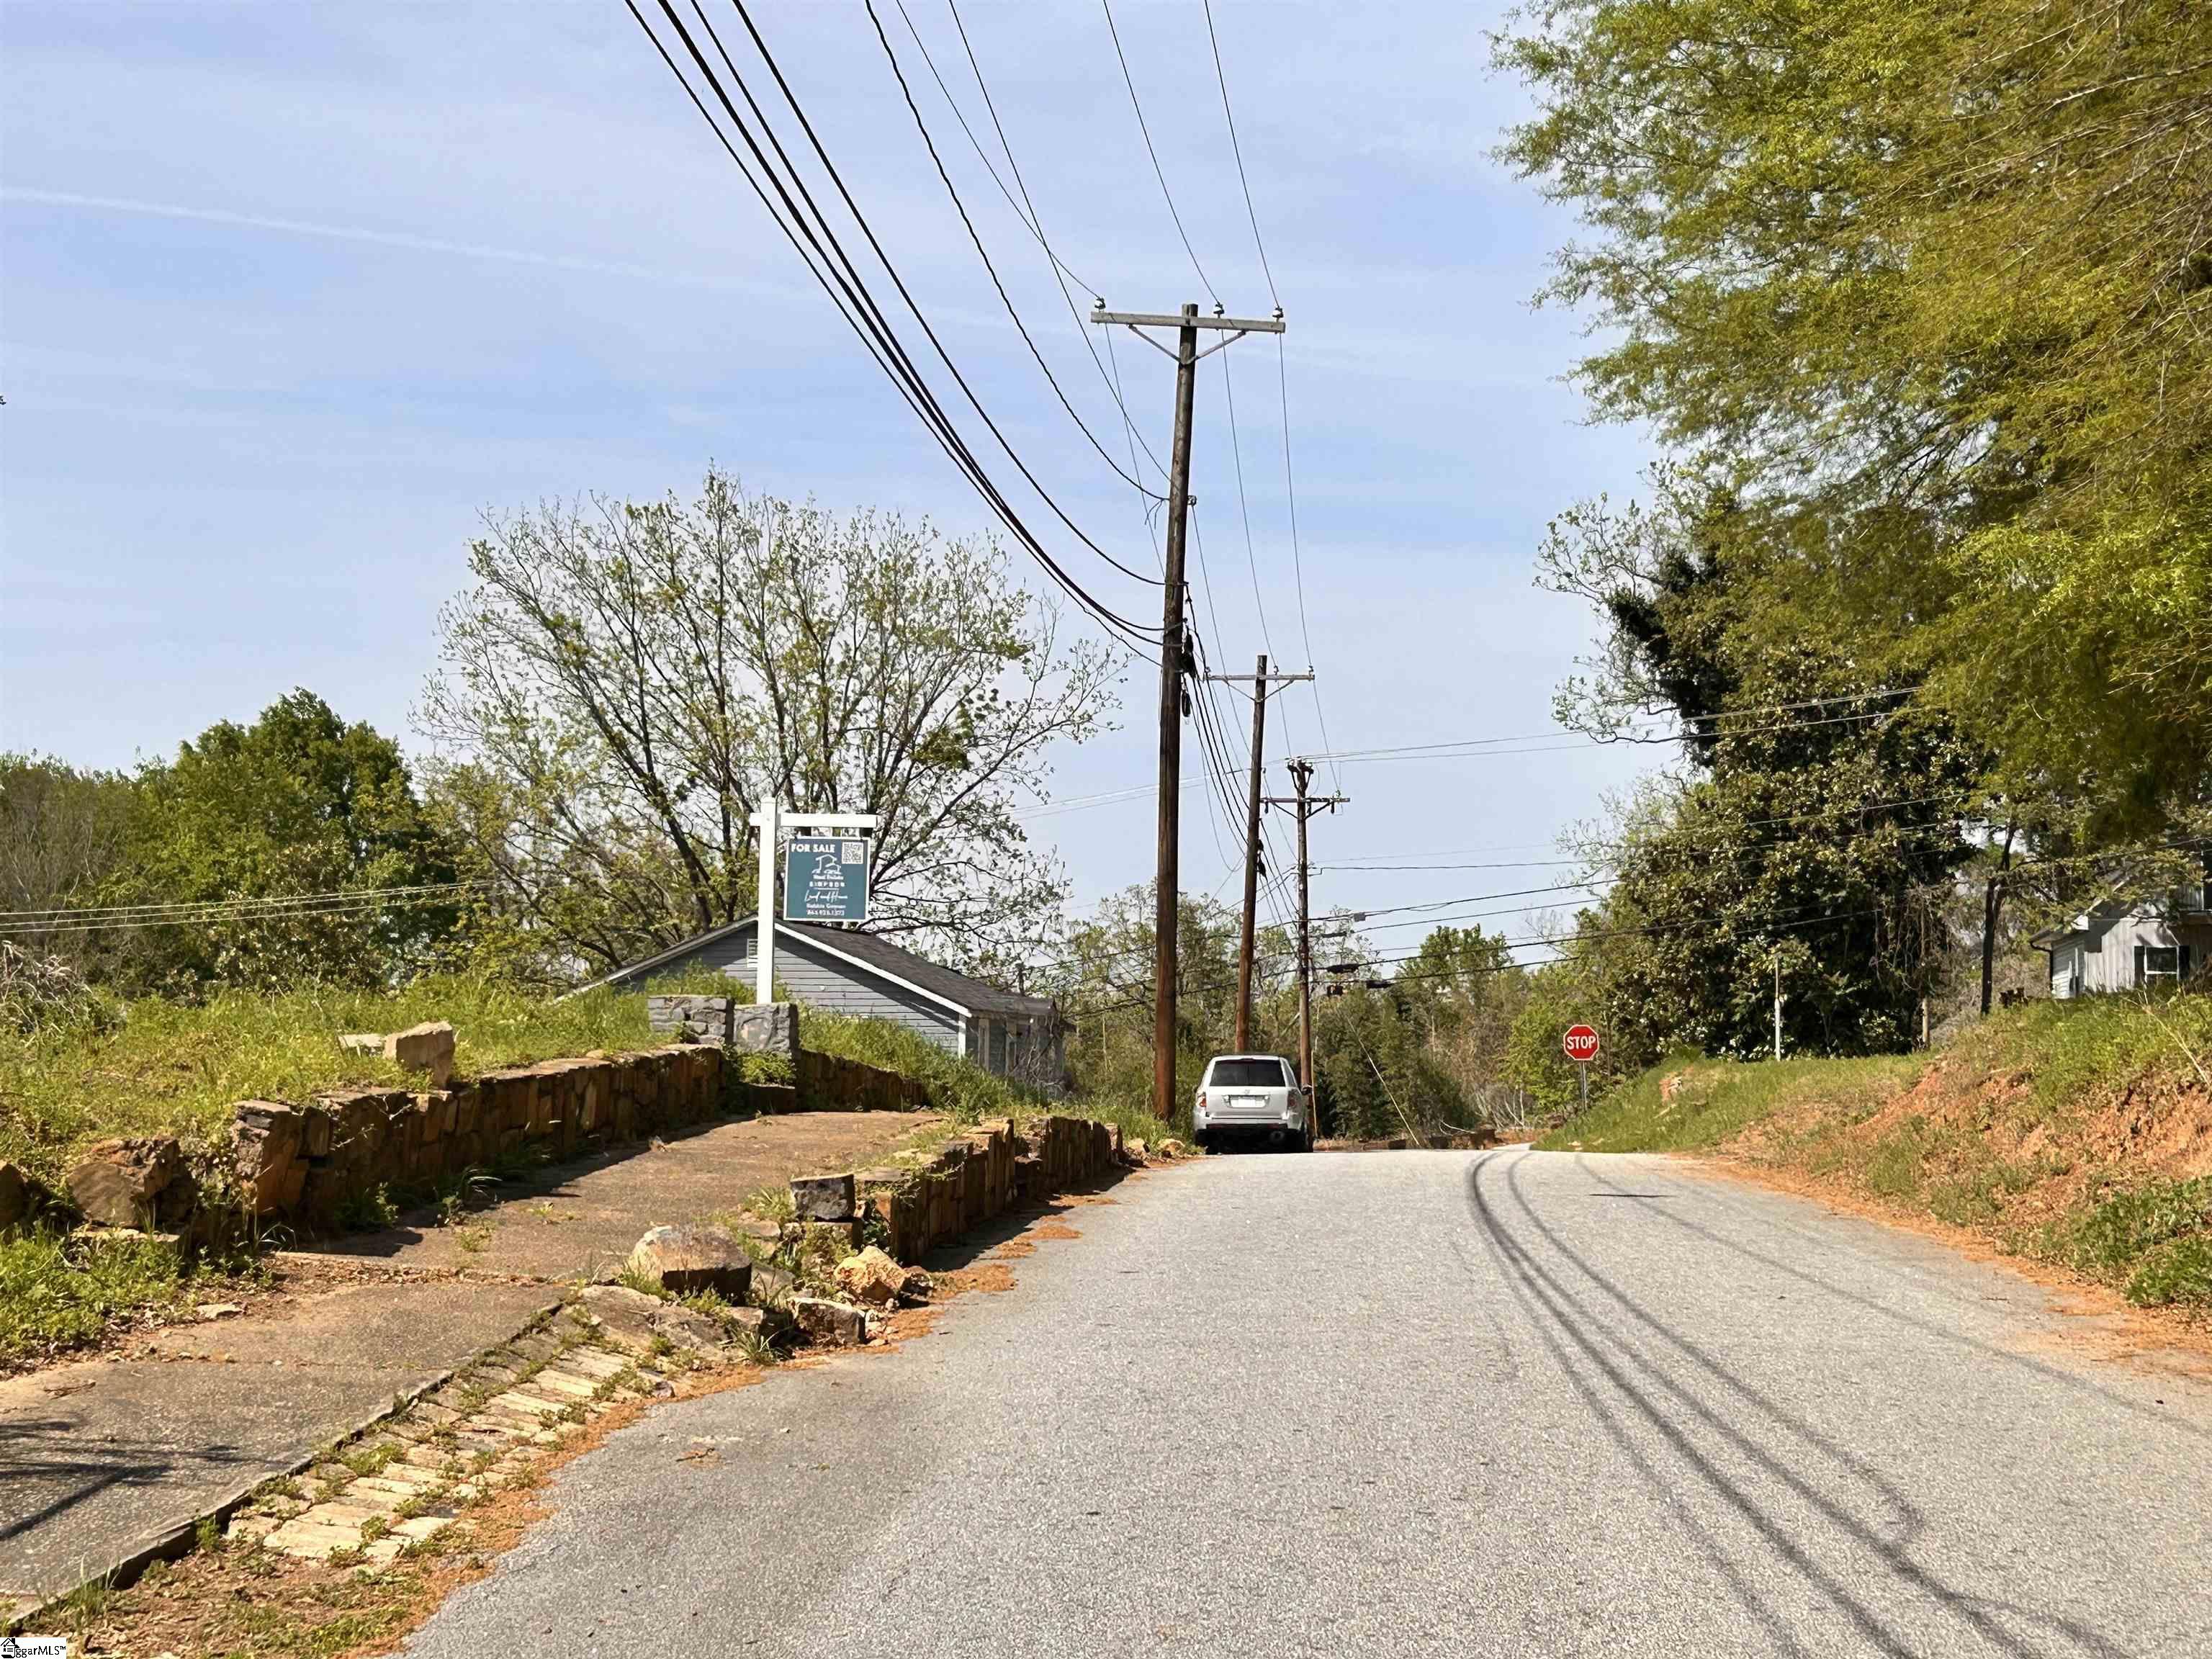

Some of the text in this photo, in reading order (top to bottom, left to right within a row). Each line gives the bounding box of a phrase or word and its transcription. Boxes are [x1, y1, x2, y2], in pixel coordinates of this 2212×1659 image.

[791, 843, 835, 853] FOR SALE
[1567, 1035, 1596, 1050] STOP
